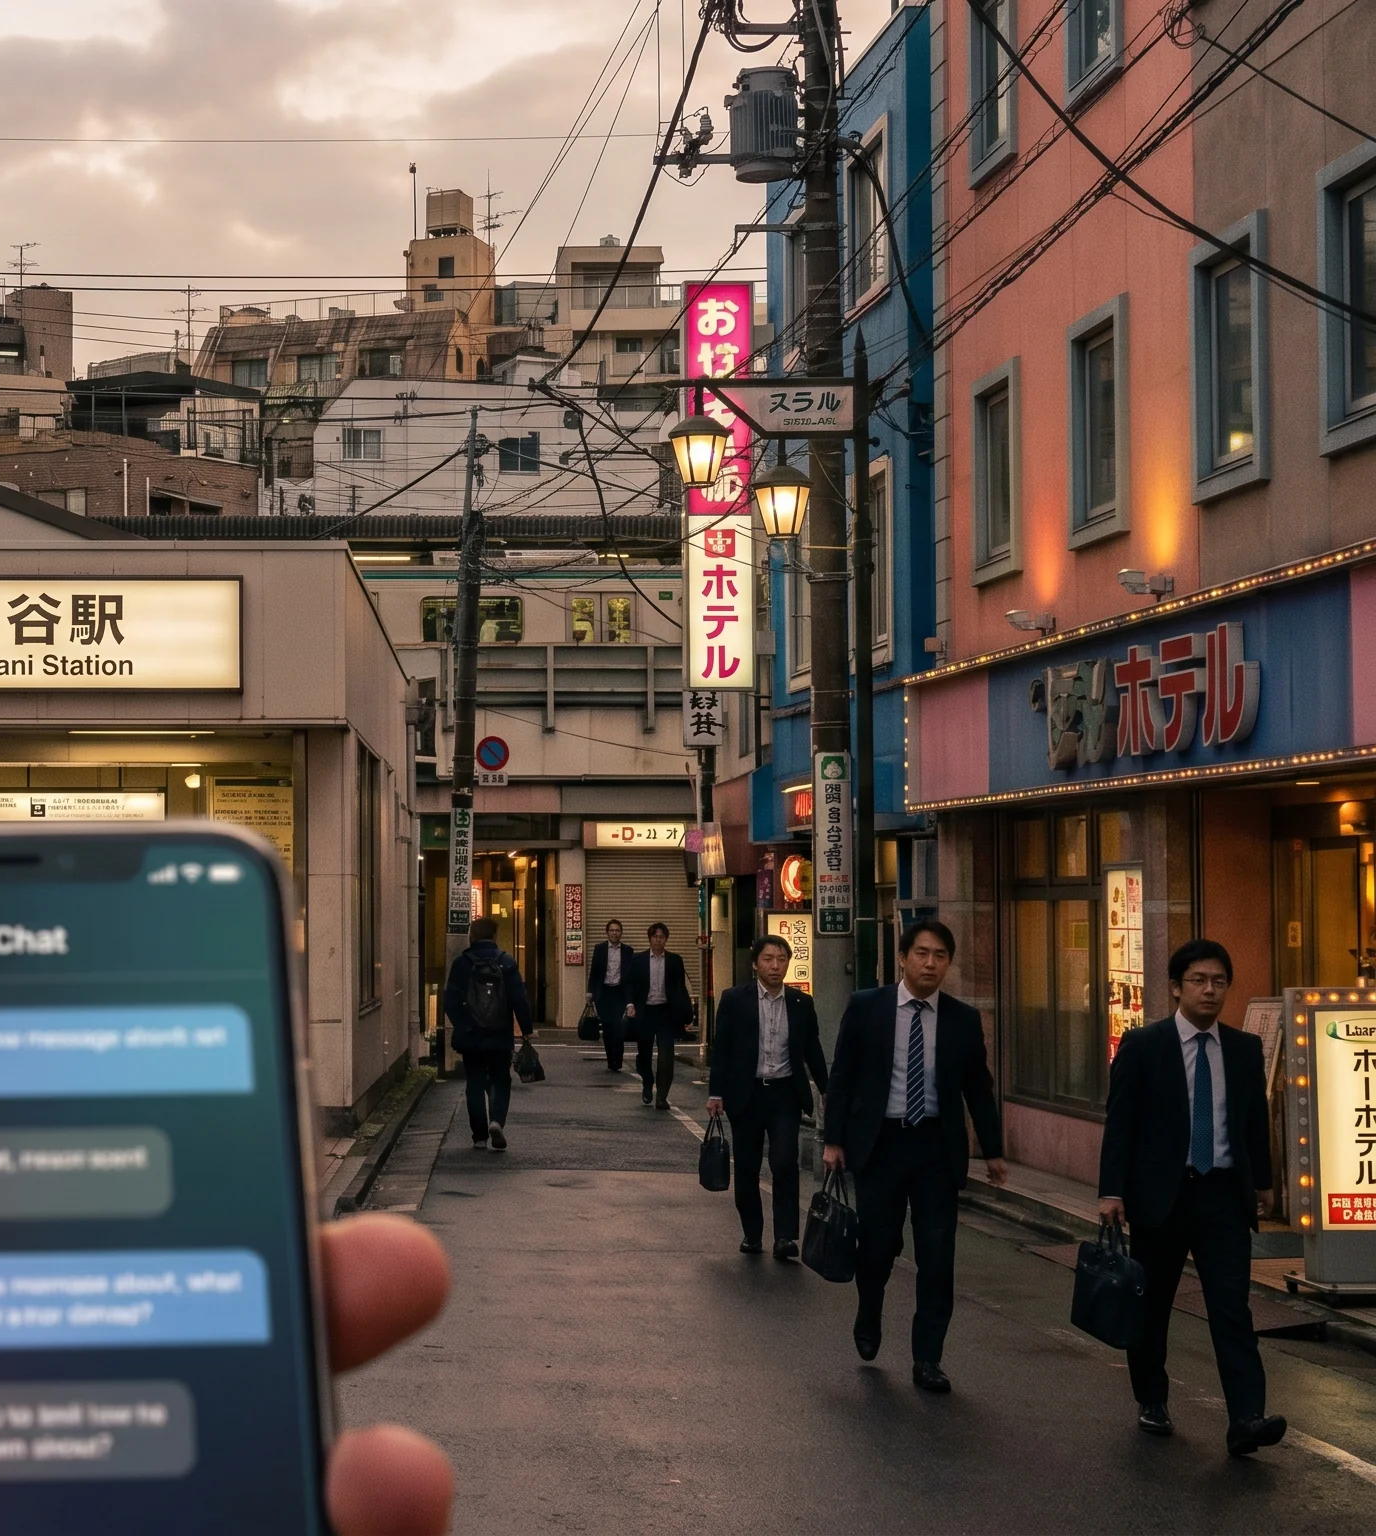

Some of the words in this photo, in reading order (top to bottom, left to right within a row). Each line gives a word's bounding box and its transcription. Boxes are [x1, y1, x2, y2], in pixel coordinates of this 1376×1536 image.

[42, 654, 134, 676] Station
[702, 564, 740, 678] ホテル
[1114, 621, 1258, 758] ホテル
